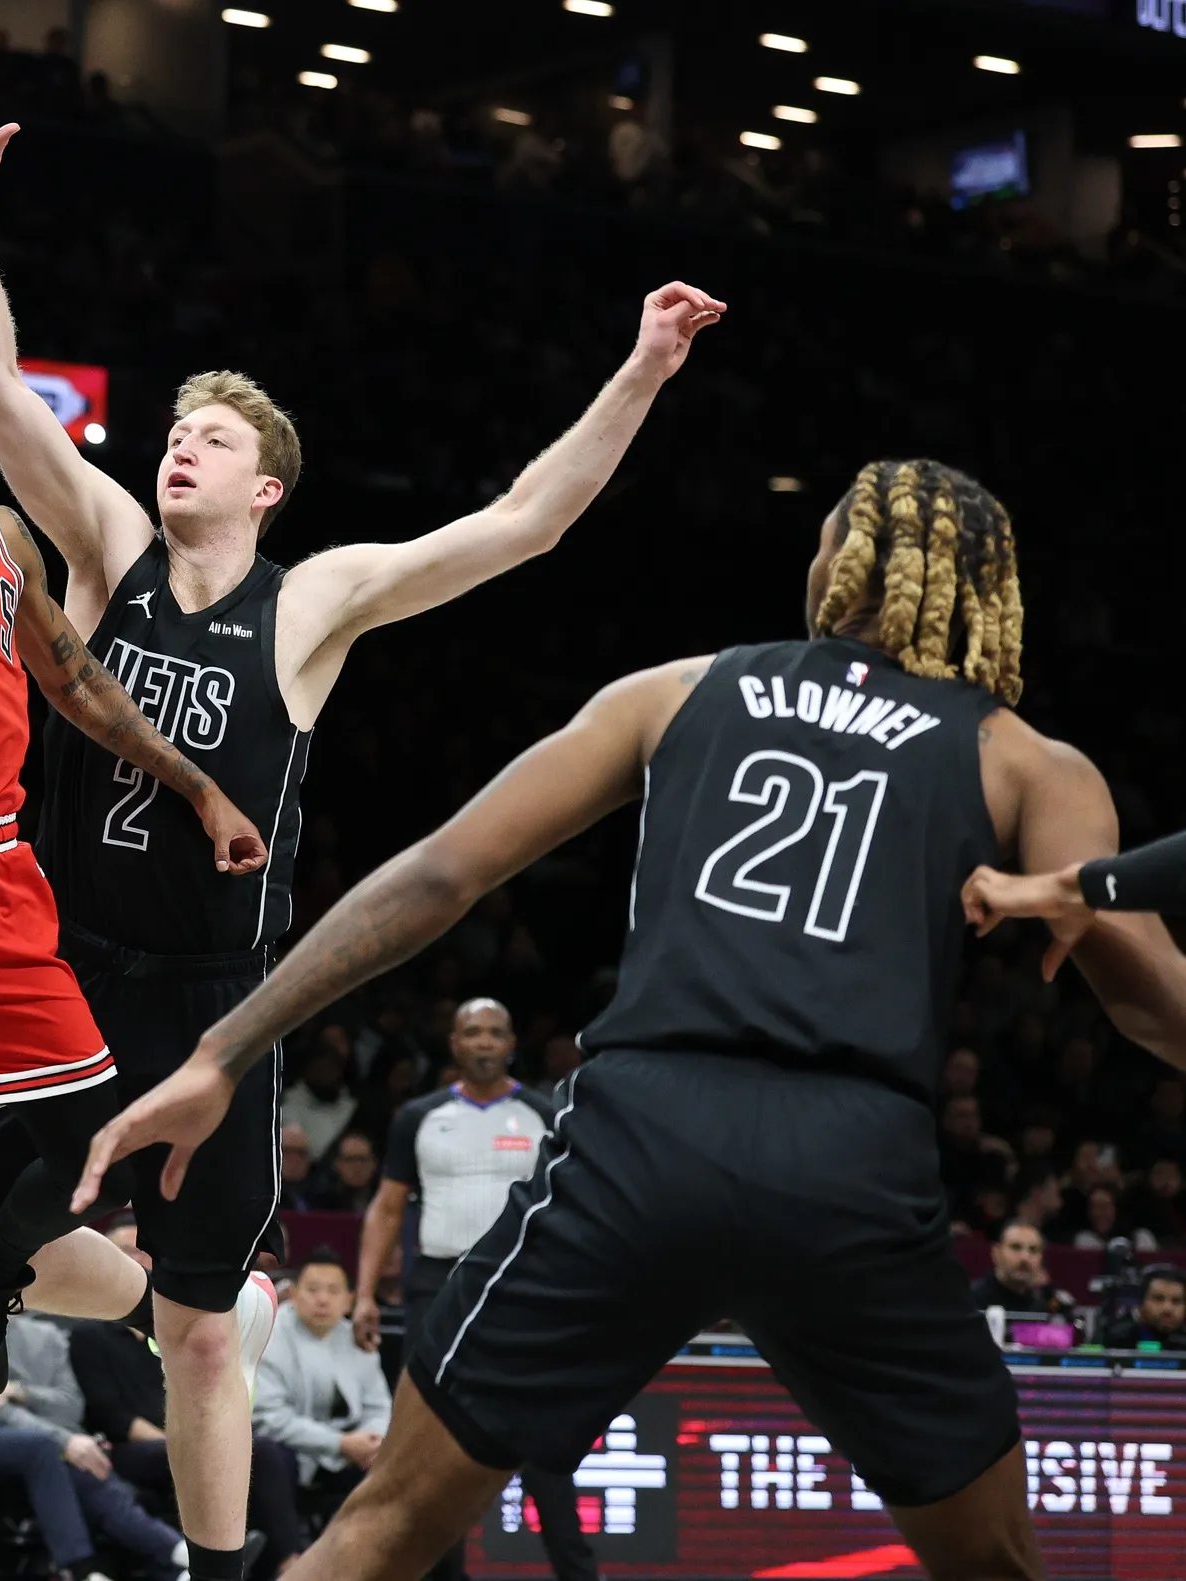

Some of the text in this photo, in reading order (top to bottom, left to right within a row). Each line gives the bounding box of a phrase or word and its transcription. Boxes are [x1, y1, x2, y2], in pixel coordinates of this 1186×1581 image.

[208, 621, 253, 638] All In Won
[102, 637, 236, 750] NETS
[738, 674, 942, 751] CLOWNEY
[102, 757, 160, 851] 2
[694, 749, 889, 943] 21
[709, 1433, 833, 1511] THE
